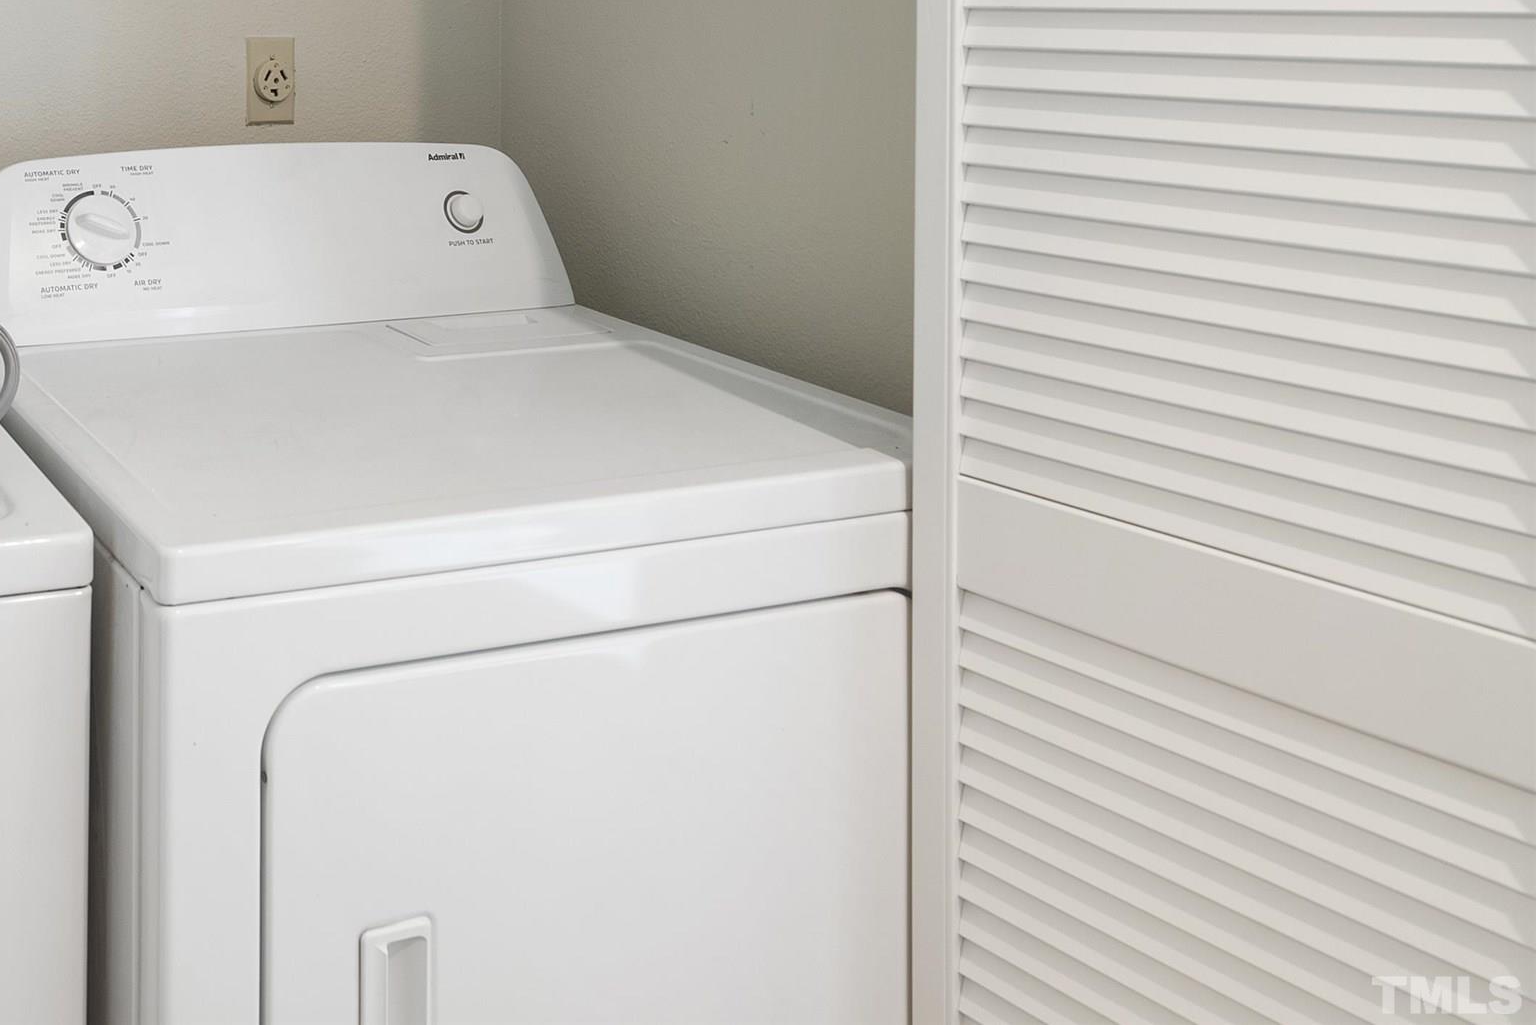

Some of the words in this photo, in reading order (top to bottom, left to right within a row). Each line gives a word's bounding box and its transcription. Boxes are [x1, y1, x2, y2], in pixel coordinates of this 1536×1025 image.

[428, 153, 458, 161] Admiral
[24, 170, 64, 178] AUTOMATIC
[40, 284, 82, 294] AUTOMATIC
